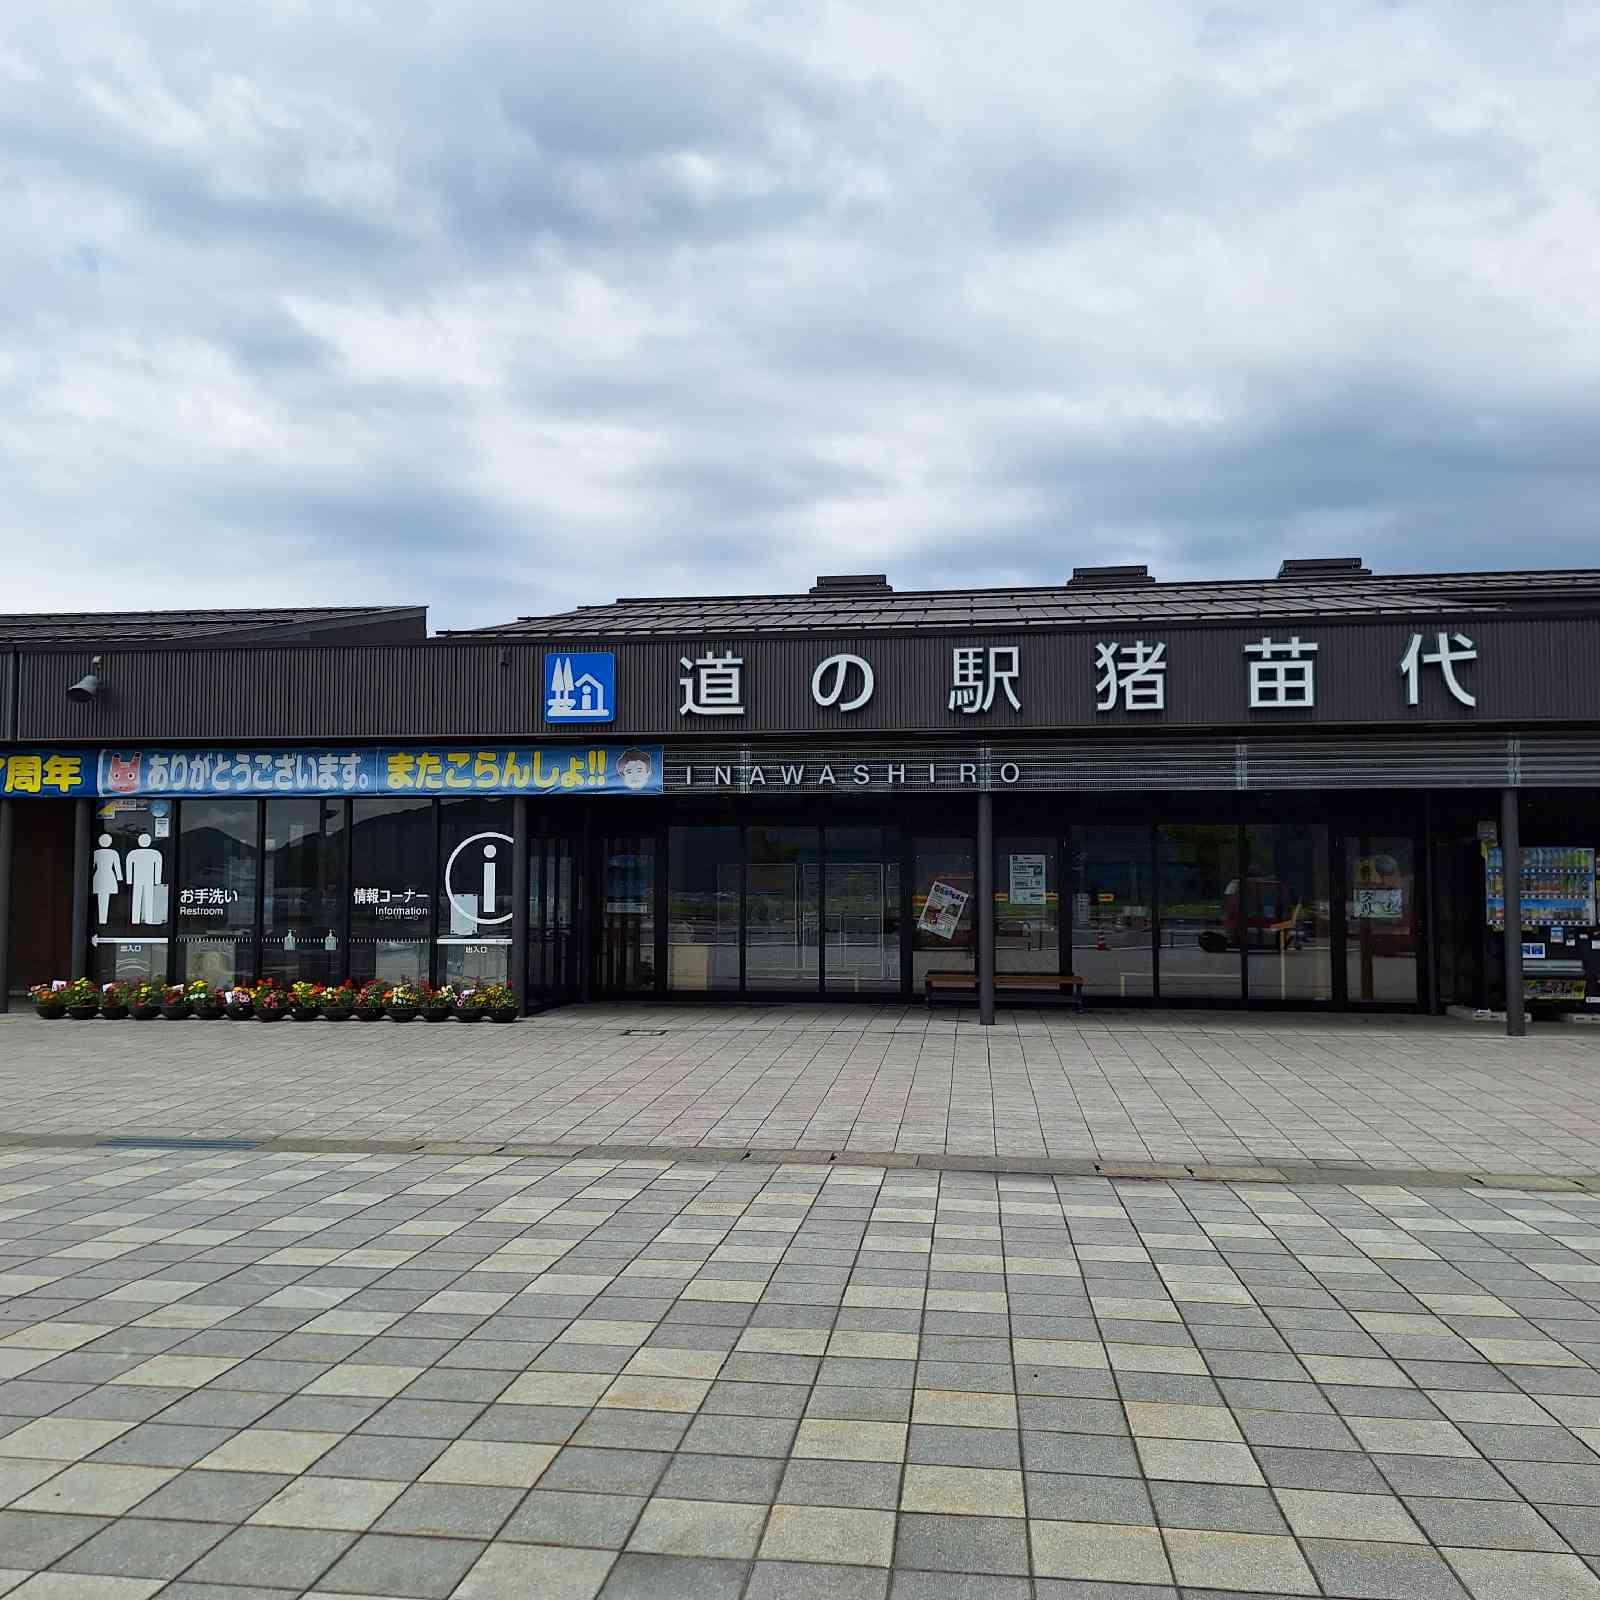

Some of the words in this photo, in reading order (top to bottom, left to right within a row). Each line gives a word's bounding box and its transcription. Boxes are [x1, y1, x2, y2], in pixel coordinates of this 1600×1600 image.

[679, 632, 1477, 716] 道の駅猪苗代
[0, 754, 82, 792] 周年
[149, 752, 369, 790] ありがとうございます。
[386, 751, 607, 790] またこらんしょ!!
[686, 761, 1020, 786] INAWASHIRO
[180, 888, 238, 904] お手洗い
[353, 887, 429, 905] 情報コーナー
[180, 906, 224, 916] Restroom
[375, 906, 428, 916] Information
[465, 946, 488, 954] 出入口
